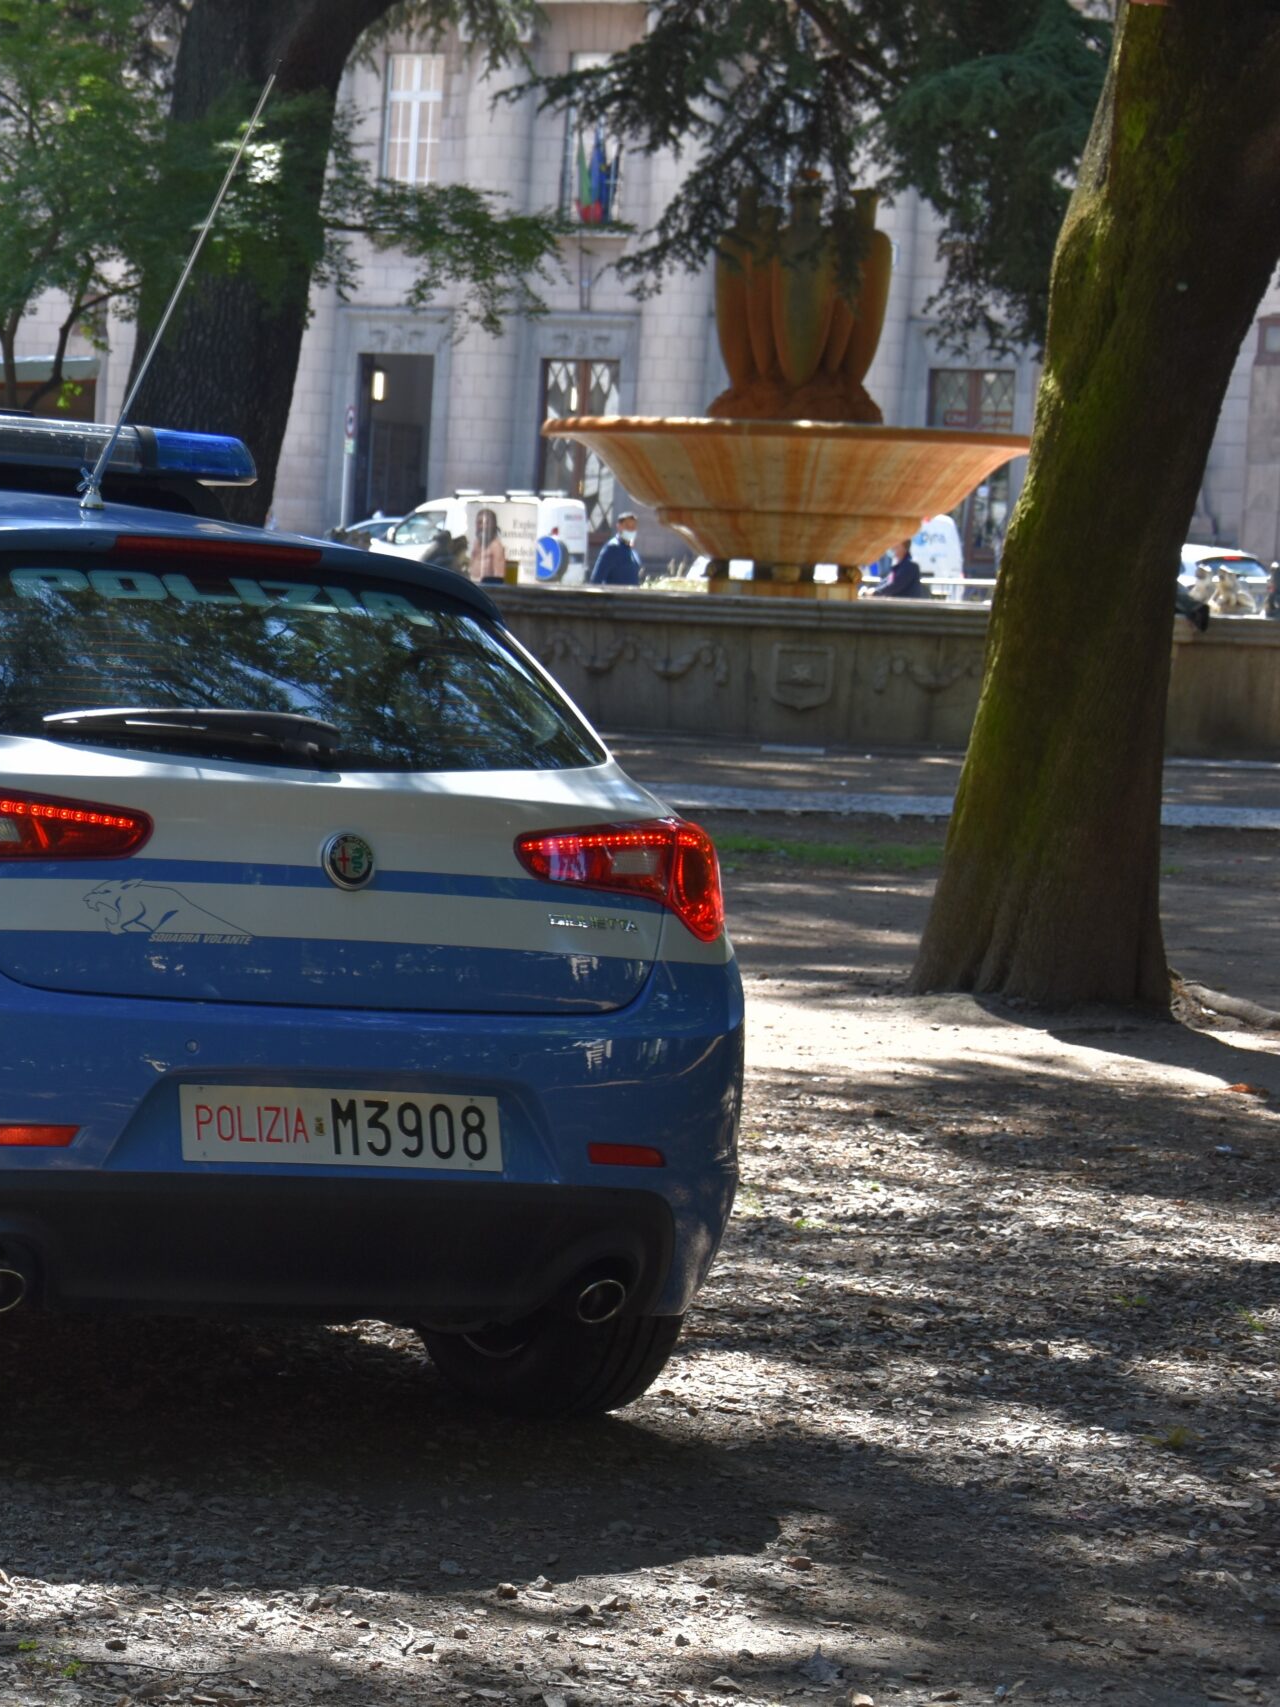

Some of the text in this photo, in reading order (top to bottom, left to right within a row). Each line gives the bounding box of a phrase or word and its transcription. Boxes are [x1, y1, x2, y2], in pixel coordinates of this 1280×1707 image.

[9, 568, 433, 627] POLIZIA
[149, 933, 252, 945] SQUADRA VOLANTE
[195, 1098, 488, 1161] POLIZIA M3908
